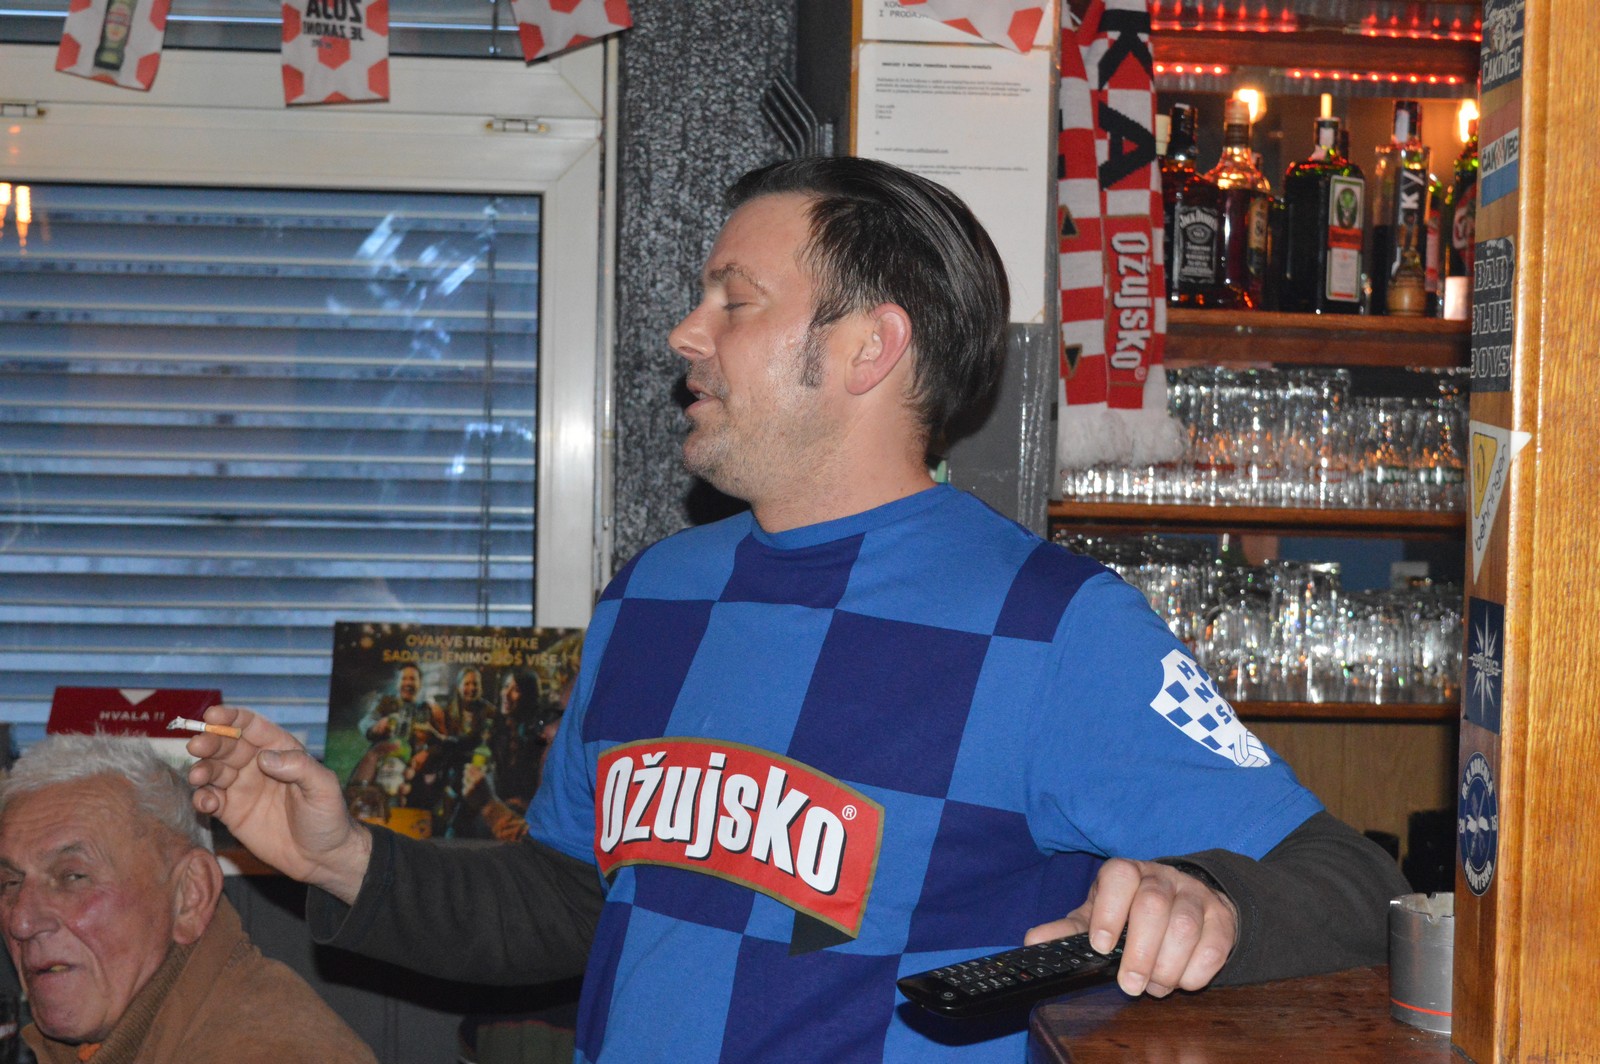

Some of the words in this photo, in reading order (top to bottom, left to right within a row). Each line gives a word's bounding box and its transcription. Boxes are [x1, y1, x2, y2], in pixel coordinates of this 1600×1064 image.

[1482, 45, 1522, 86] ČAKOVEC
[1474, 255, 1509, 293] BAD
[1111, 231, 1152, 370] Ožujsko
[1472, 299, 1512, 336] BLUE
[1470, 344, 1511, 379] BOYS
[1474, 443, 1507, 552] behringer
[382, 649, 421, 663] SADA
[422, 650, 493, 665] CIJENIMO
[405, 634, 464, 648] OVAKVE
[466, 635, 539, 650] TRENUTKE
[1176, 660, 1232, 725] HNS
[99, 711, 150, 721] HVALA
[600, 751, 847, 895] Ožujsko
